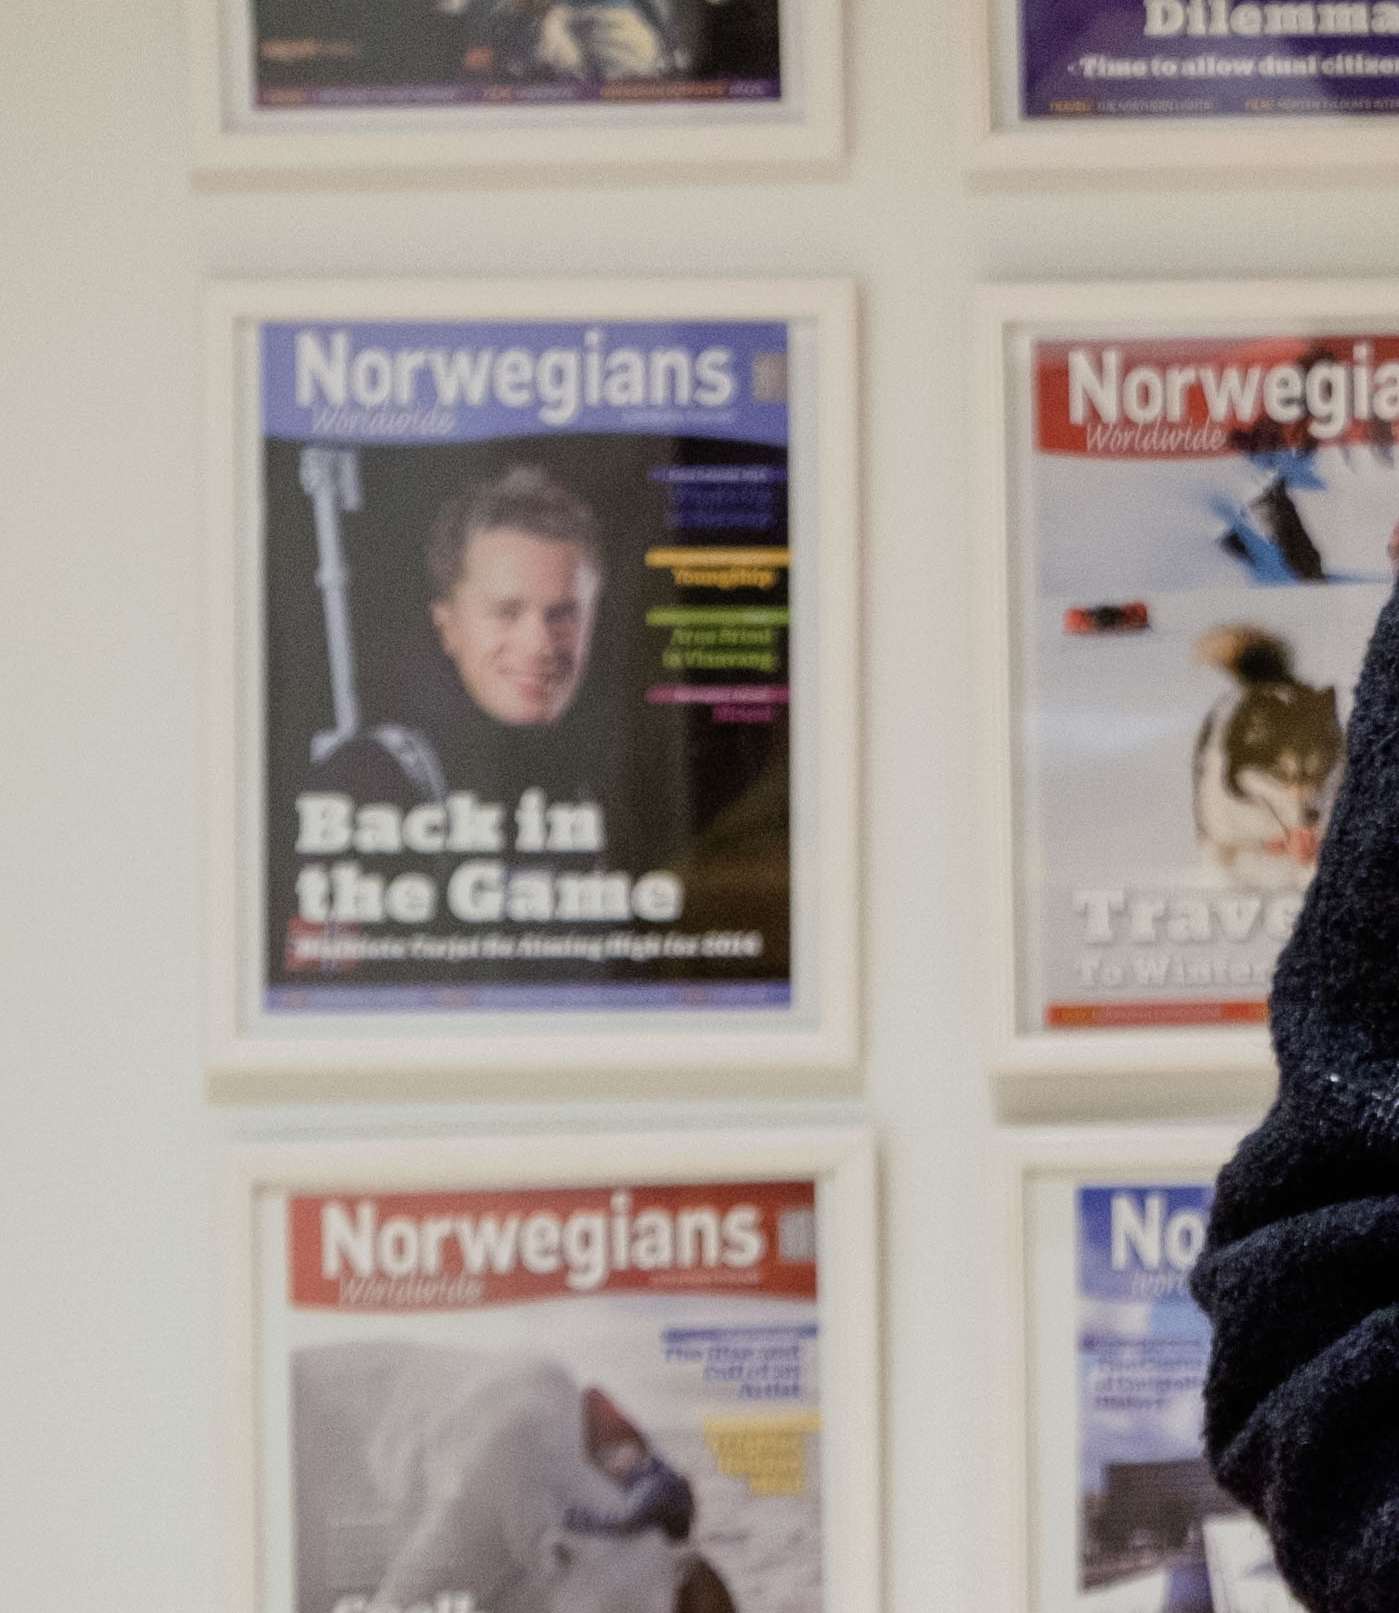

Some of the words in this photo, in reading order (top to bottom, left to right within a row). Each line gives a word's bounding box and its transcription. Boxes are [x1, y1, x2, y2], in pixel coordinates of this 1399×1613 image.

[1079, 54, 1149, 78] Time
[1151, 57, 1179, 78] to
[1181, 53, 1255, 78] allow
[1257, 53, 1320, 78] dual
[295, 329, 735, 426] Norwegians
[1087, 415, 1226, 453] Worldwide
[296, 789, 503, 853] Back
[515, 789, 605, 852] in
[297, 860, 436, 924] the
[447, 859, 684, 923] Game
[321, 1189, 765, 1290] Norwegians
